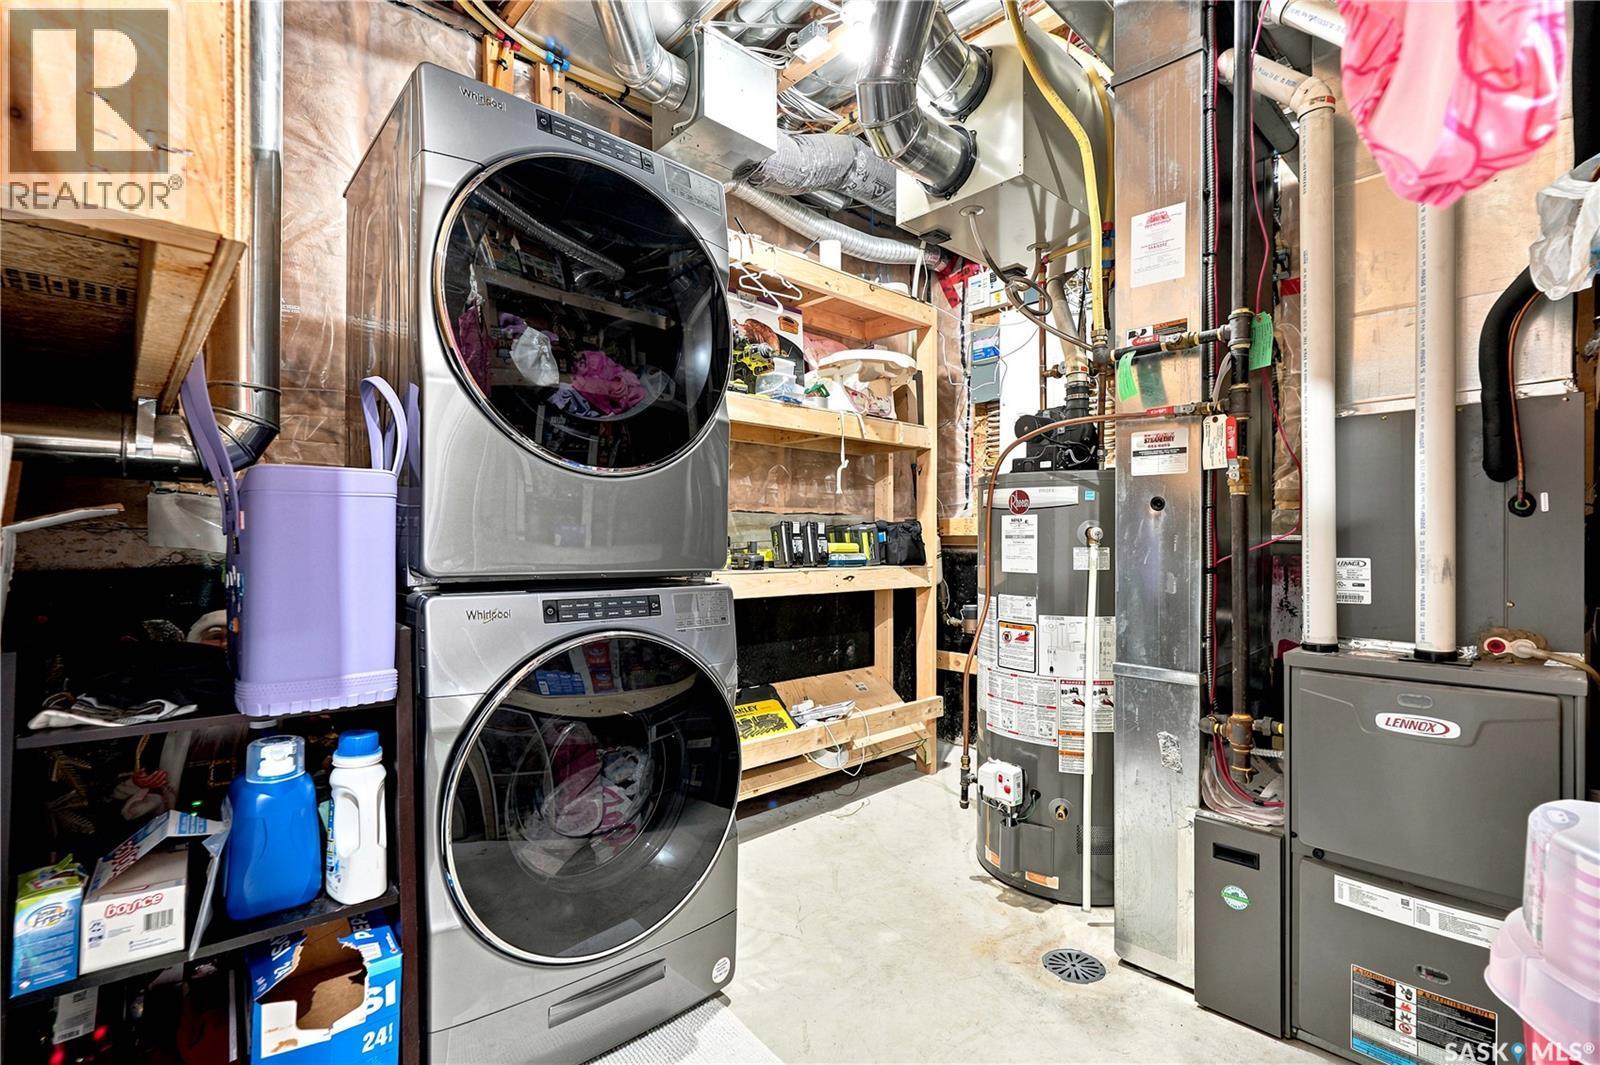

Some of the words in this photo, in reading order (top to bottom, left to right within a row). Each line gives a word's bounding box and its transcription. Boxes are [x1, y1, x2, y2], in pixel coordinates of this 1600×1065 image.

[458, 85, 507, 112] Whirlpool
[465, 608, 511, 624] Whirlpool
[1384, 717, 1437, 733] LENNOX
[104, 892, 164, 919] bounce
[362, 1022, 394, 1054] 24!
